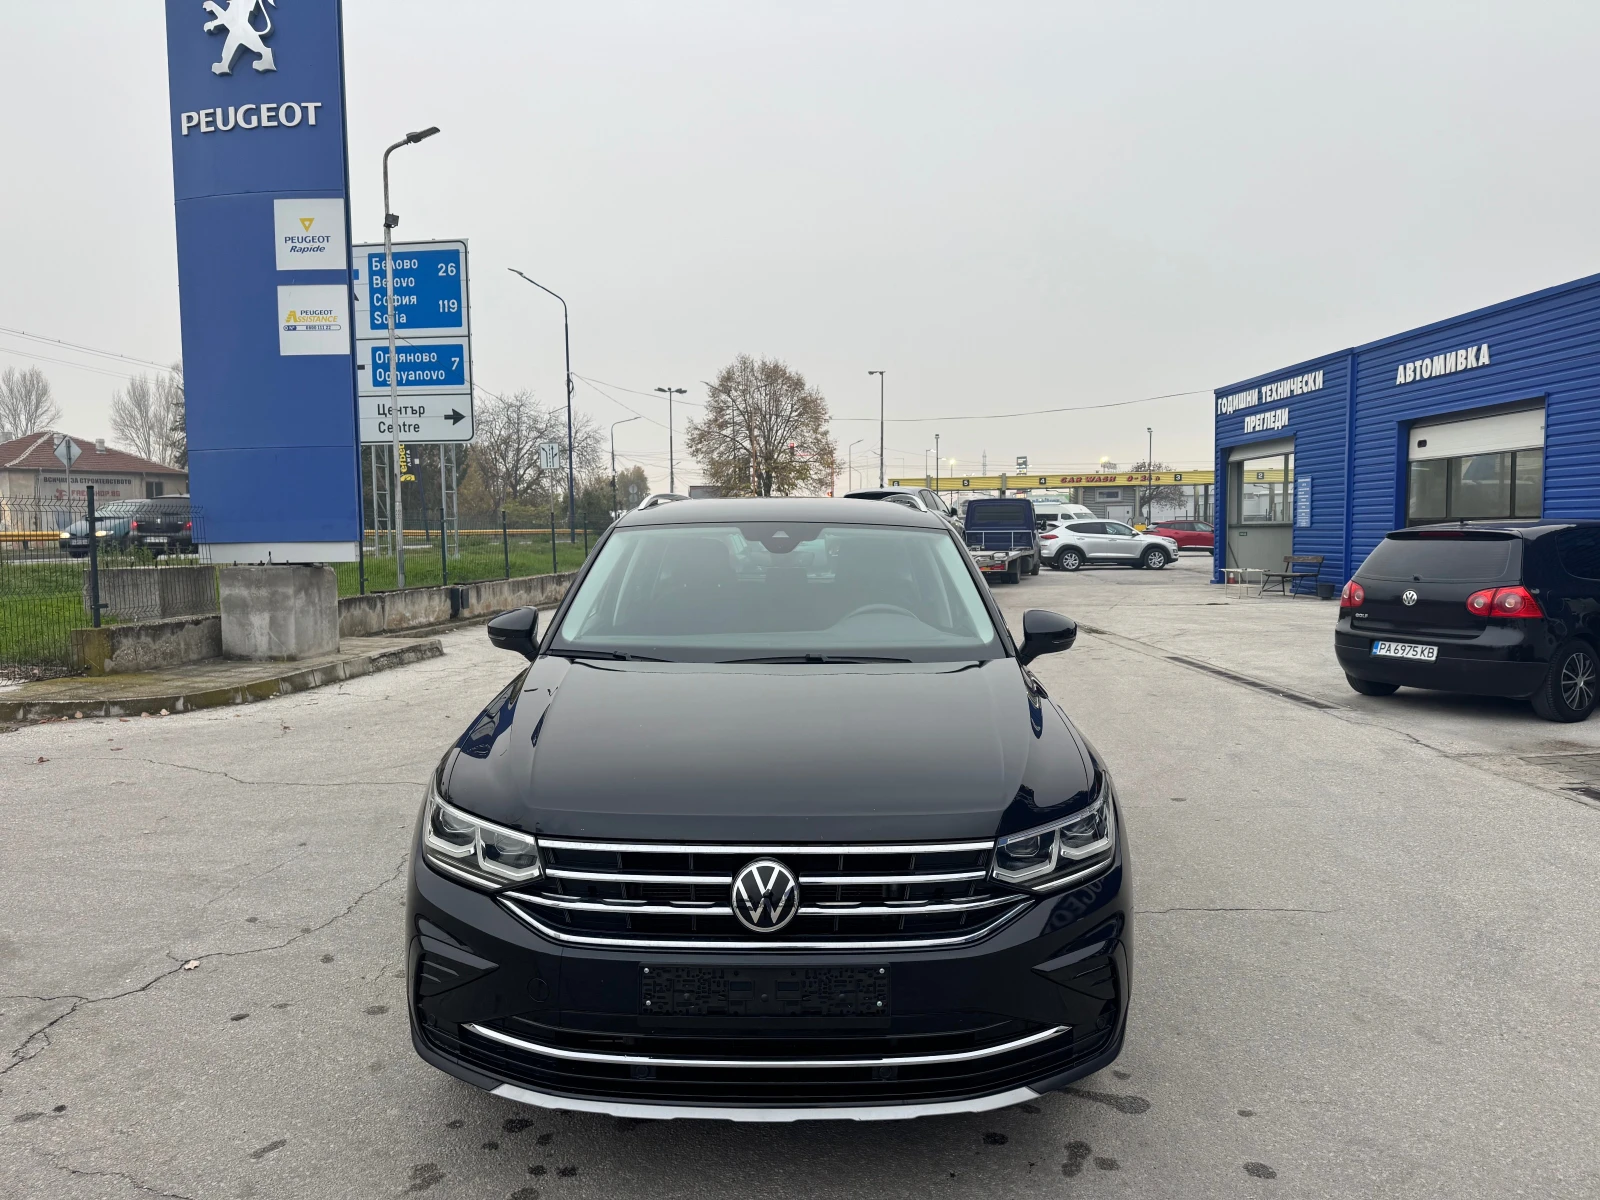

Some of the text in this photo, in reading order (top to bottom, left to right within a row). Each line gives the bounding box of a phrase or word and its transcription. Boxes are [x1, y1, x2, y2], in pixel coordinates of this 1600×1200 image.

[180, 102, 322, 136] PEUGEOT
[284, 235, 331, 244] PEUGEOT
[290, 245, 326, 254] Rapide
[437, 263, 457, 276] 26
[373, 275, 415, 288] Beovo
[438, 299, 458, 312] 119
[374, 311, 407, 324] Soia
[451, 357, 460, 370] 7
[1396, 343, 1490, 385] АВТОМИВКА
[1217, 370, 1323, 414] ГОДИШНИ ТЕХНИЧЕСКИ
[1244, 408, 1289, 433] ПРЕГЛЕДИ
[1060, 476, 1082, 484] CAR
[1085, 475, 1117, 483] WASH
